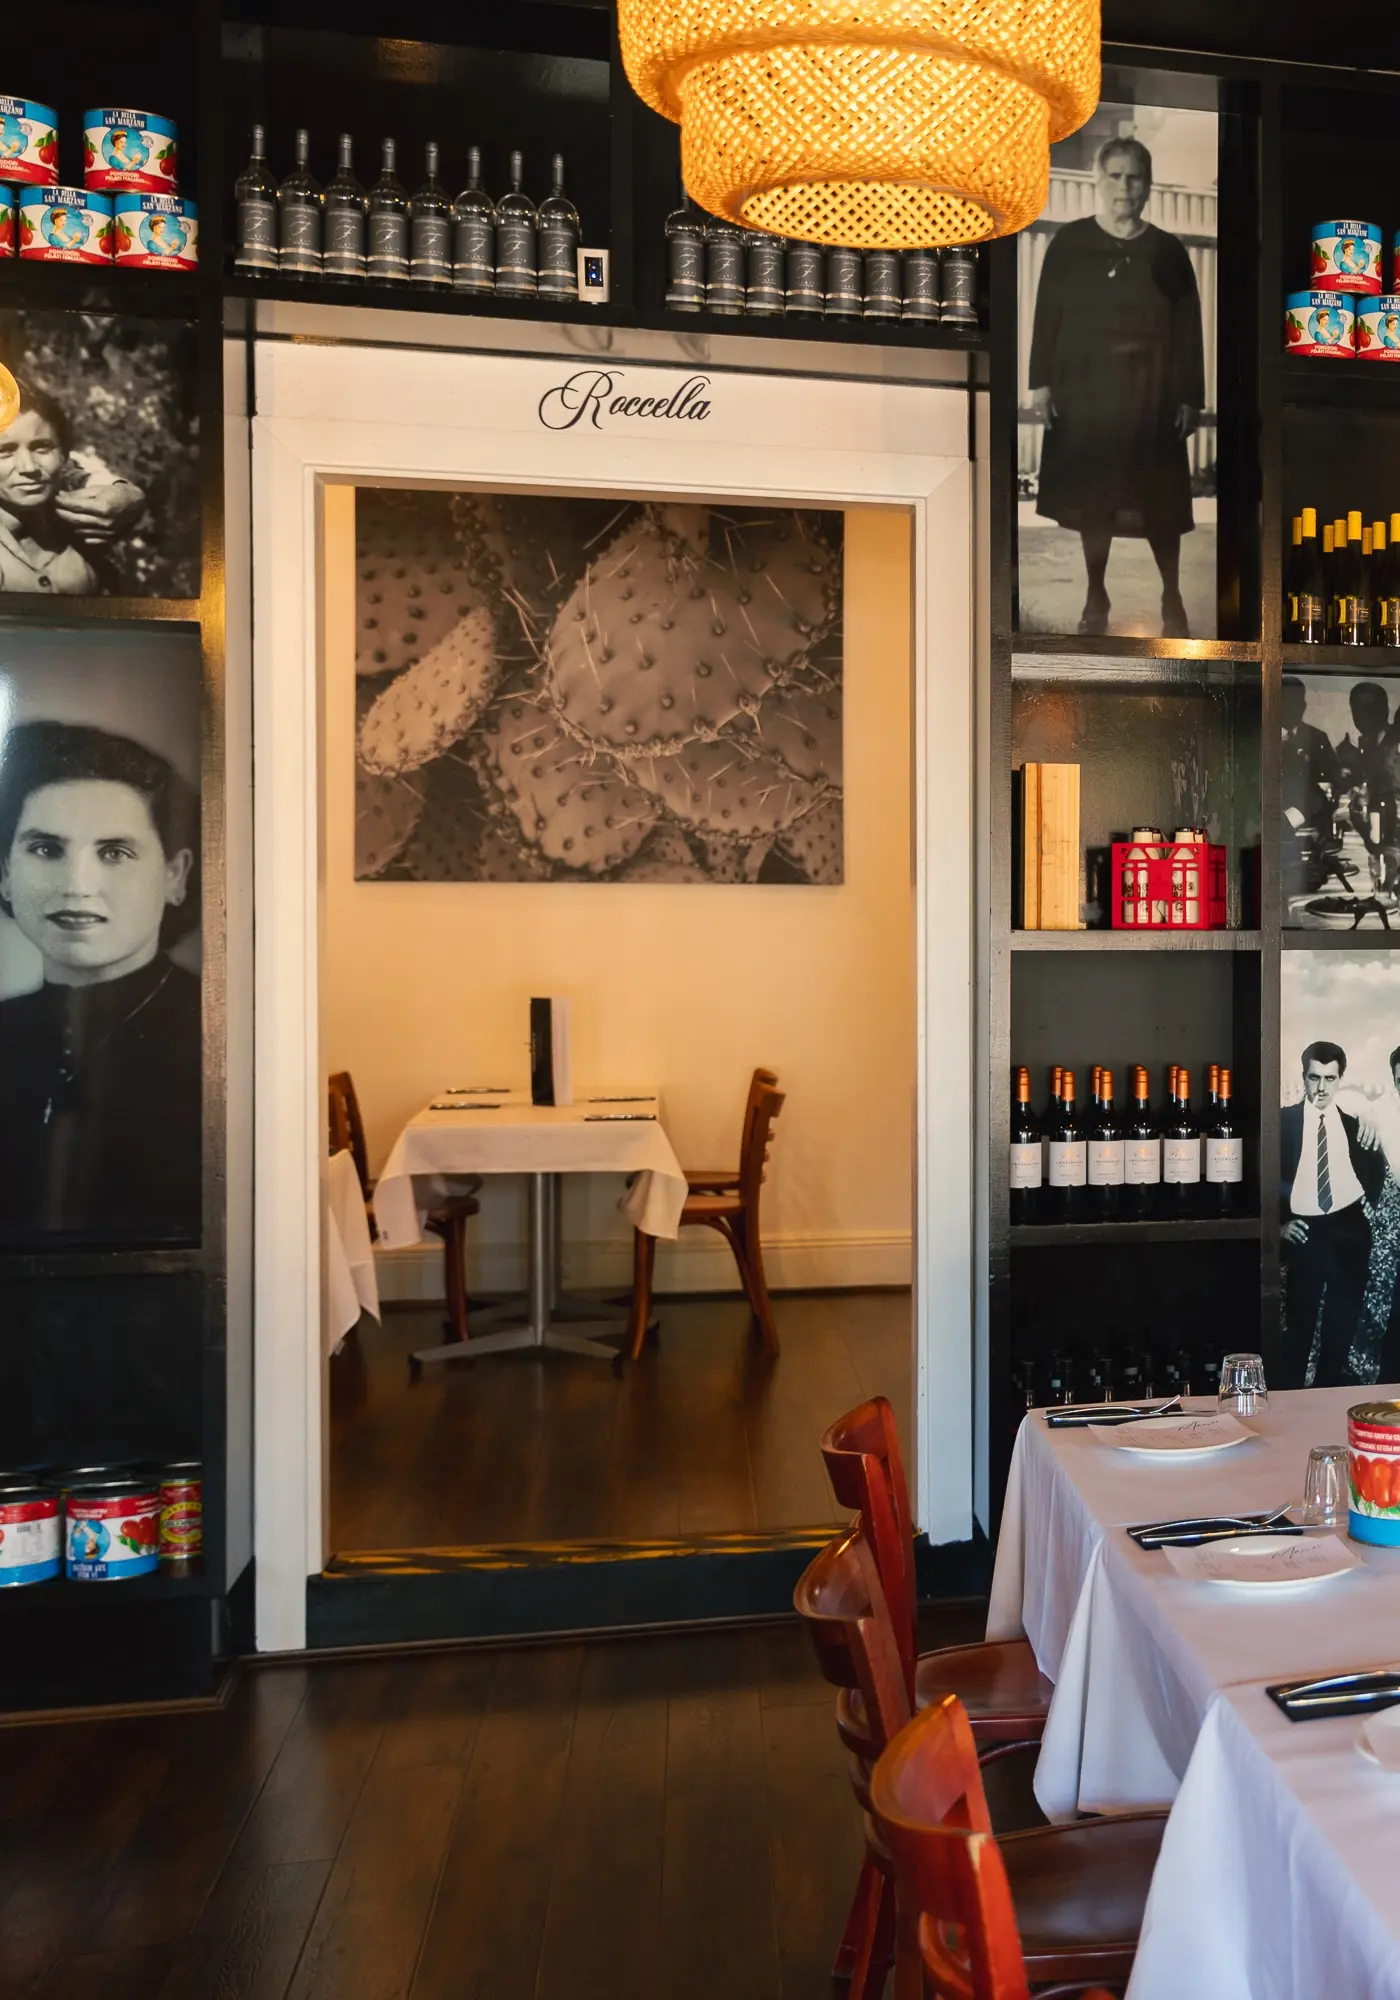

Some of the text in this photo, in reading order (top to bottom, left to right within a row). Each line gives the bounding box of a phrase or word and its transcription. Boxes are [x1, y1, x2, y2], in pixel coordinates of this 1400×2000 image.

[105, 117, 146, 128] SAN MARZANO
[44, 195, 86, 207] SAN MARZANO
[538, 370, 712, 430] Roccella
